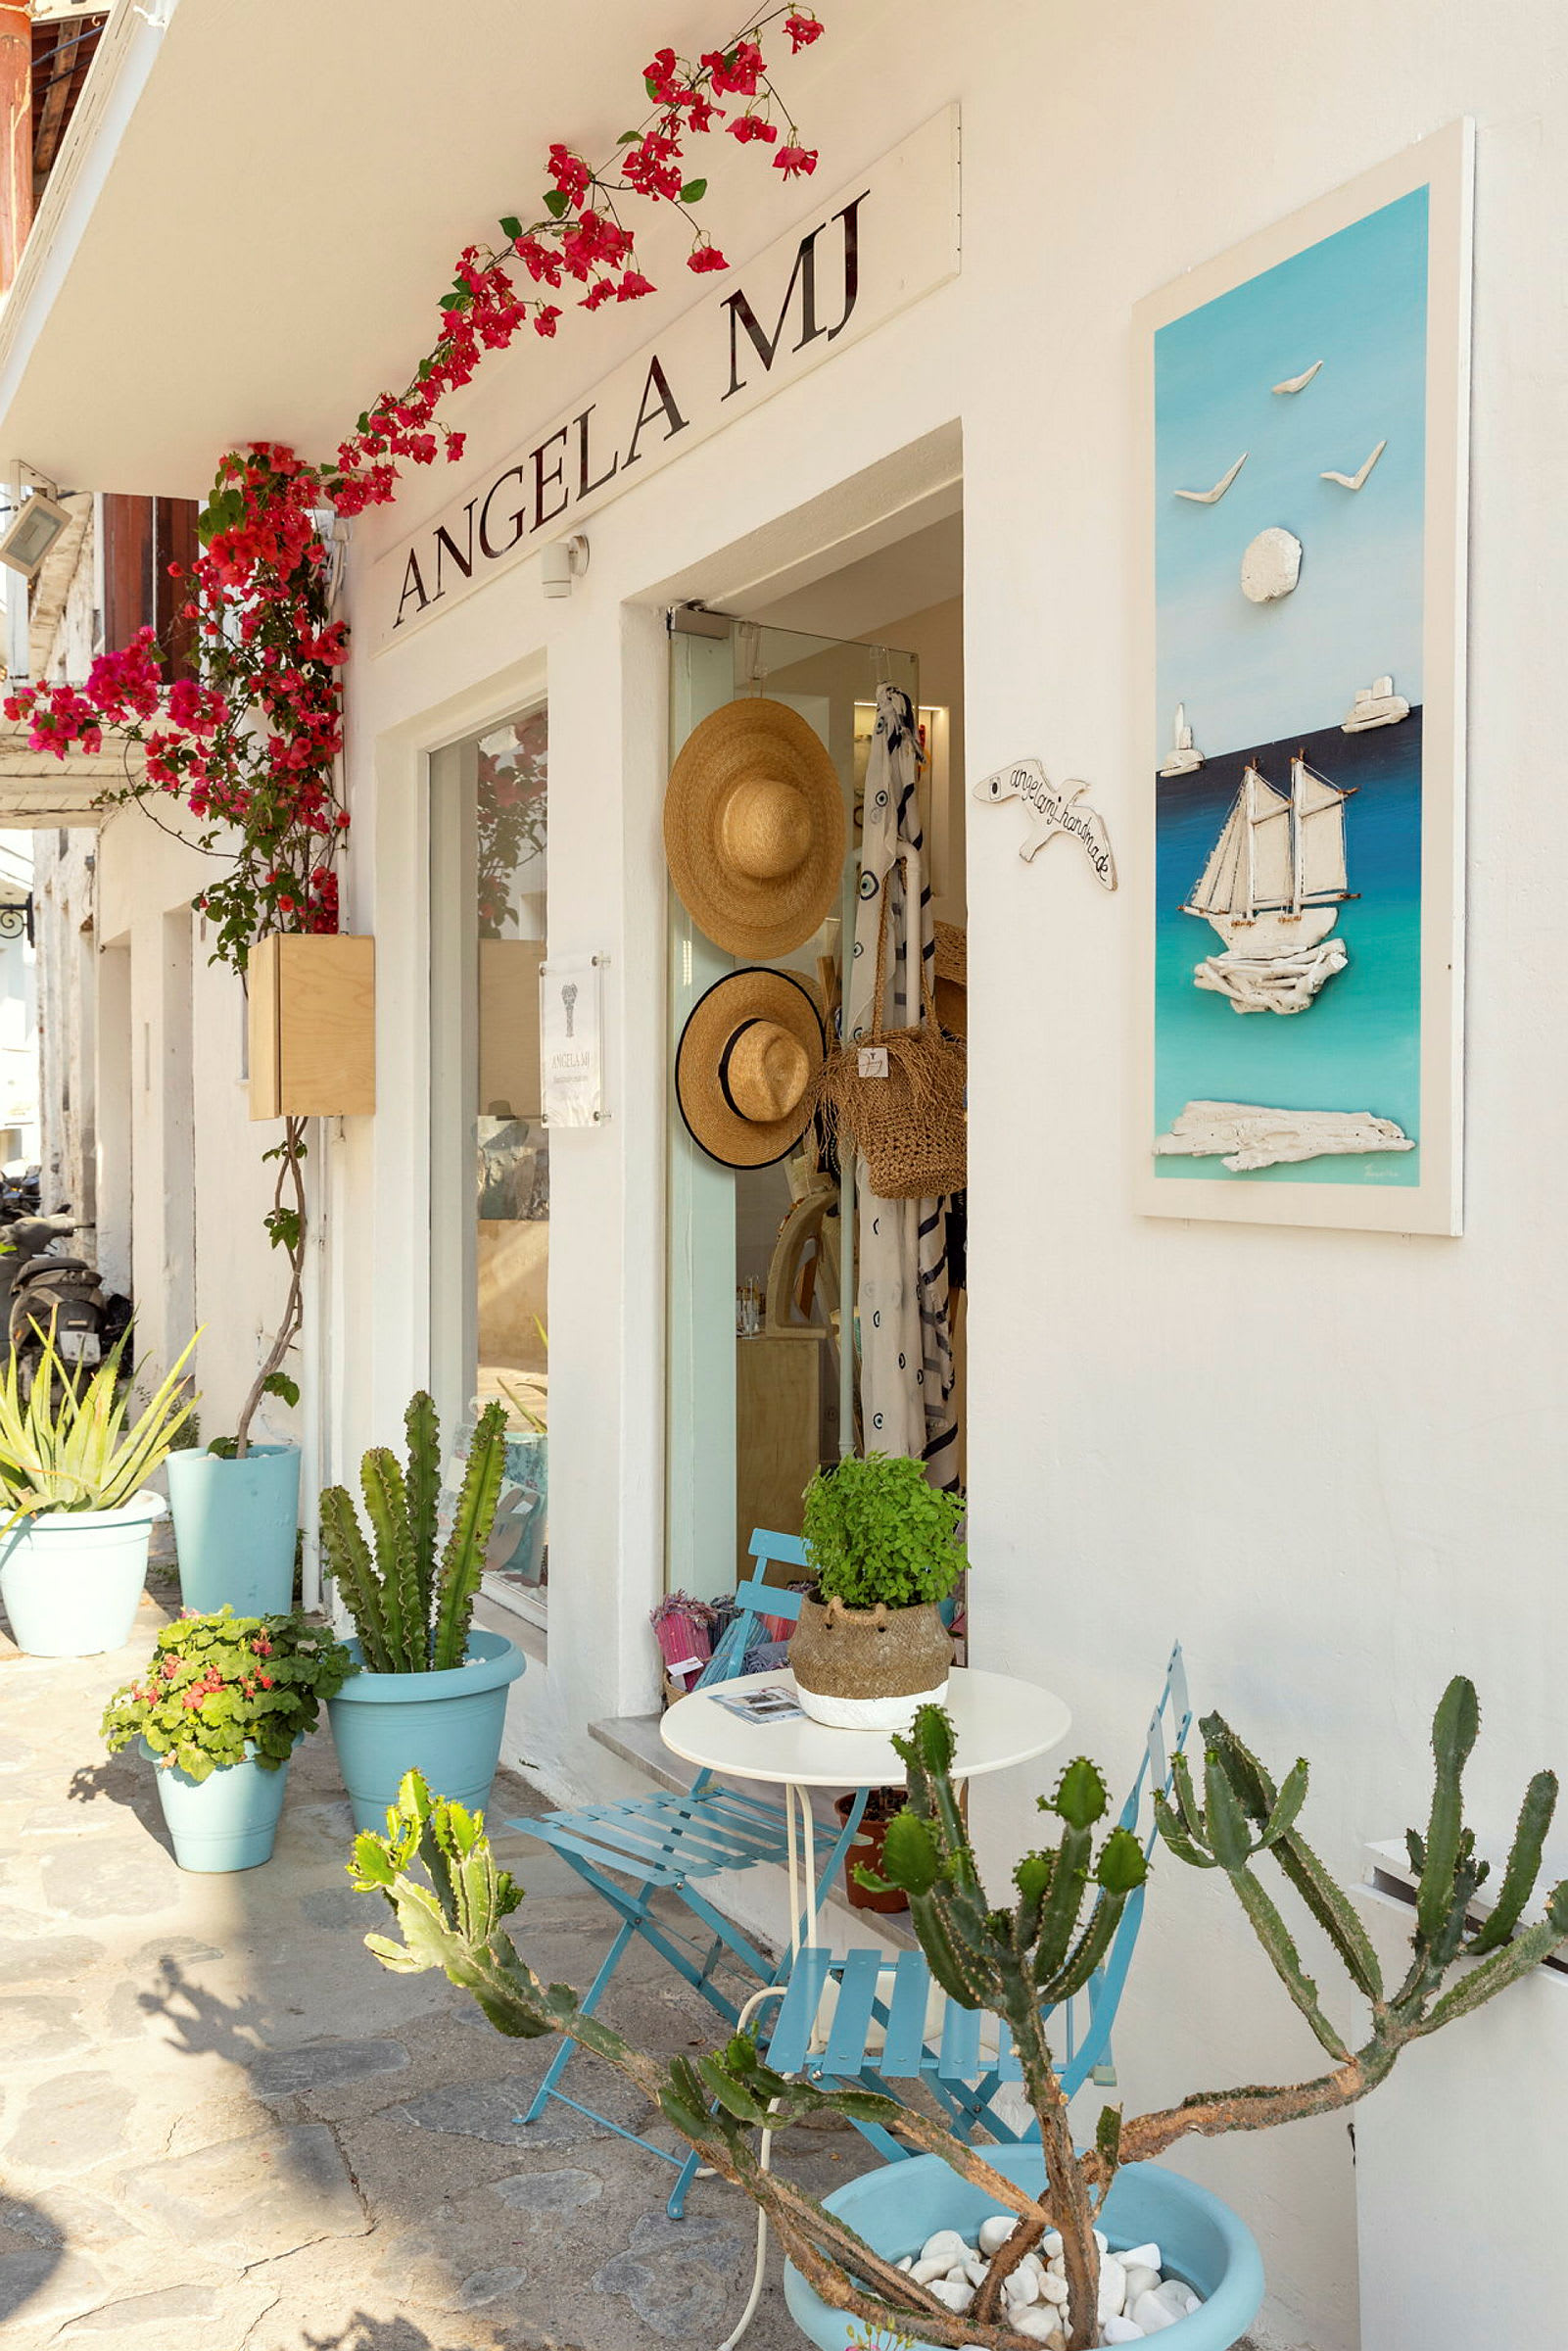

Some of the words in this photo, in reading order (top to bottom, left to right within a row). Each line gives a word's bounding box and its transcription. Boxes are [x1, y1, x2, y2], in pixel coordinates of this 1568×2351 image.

[393, 354, 689, 629] ANGELA
[720, 189, 871, 403] MJ
[551, 1051, 580, 1070] ANGELA
